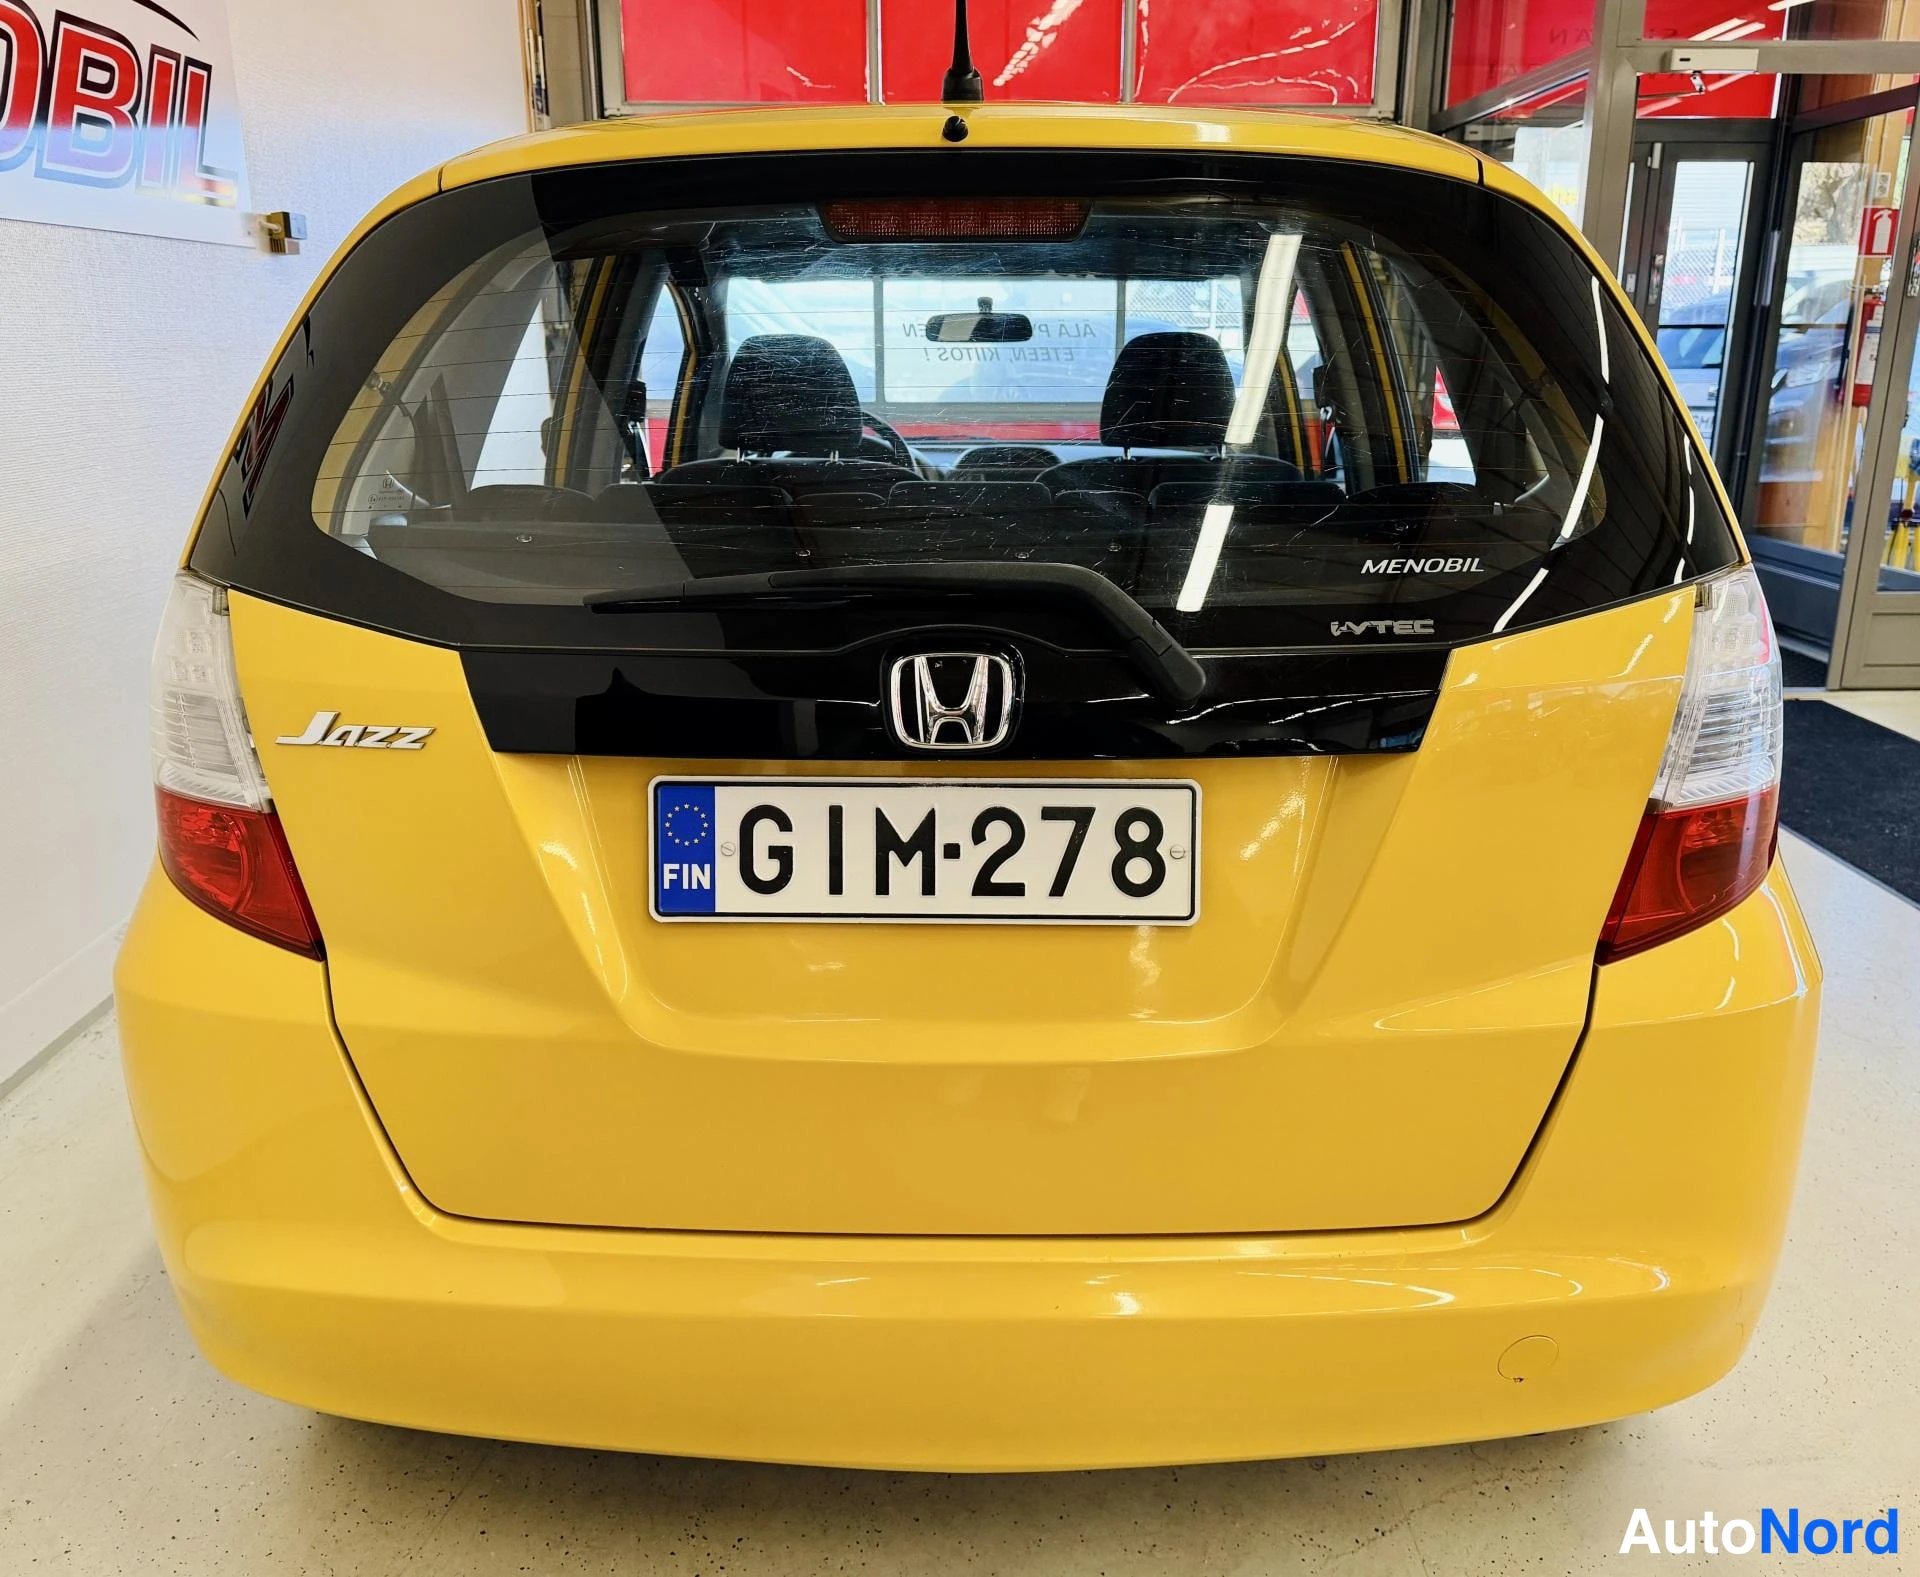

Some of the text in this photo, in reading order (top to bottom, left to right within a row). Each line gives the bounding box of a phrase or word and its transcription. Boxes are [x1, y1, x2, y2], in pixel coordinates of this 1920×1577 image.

[1360, 557, 1485, 574] MENOBIL
[738, 803, 1168, 899] GIM-278
[662, 863, 712, 891] FIN
